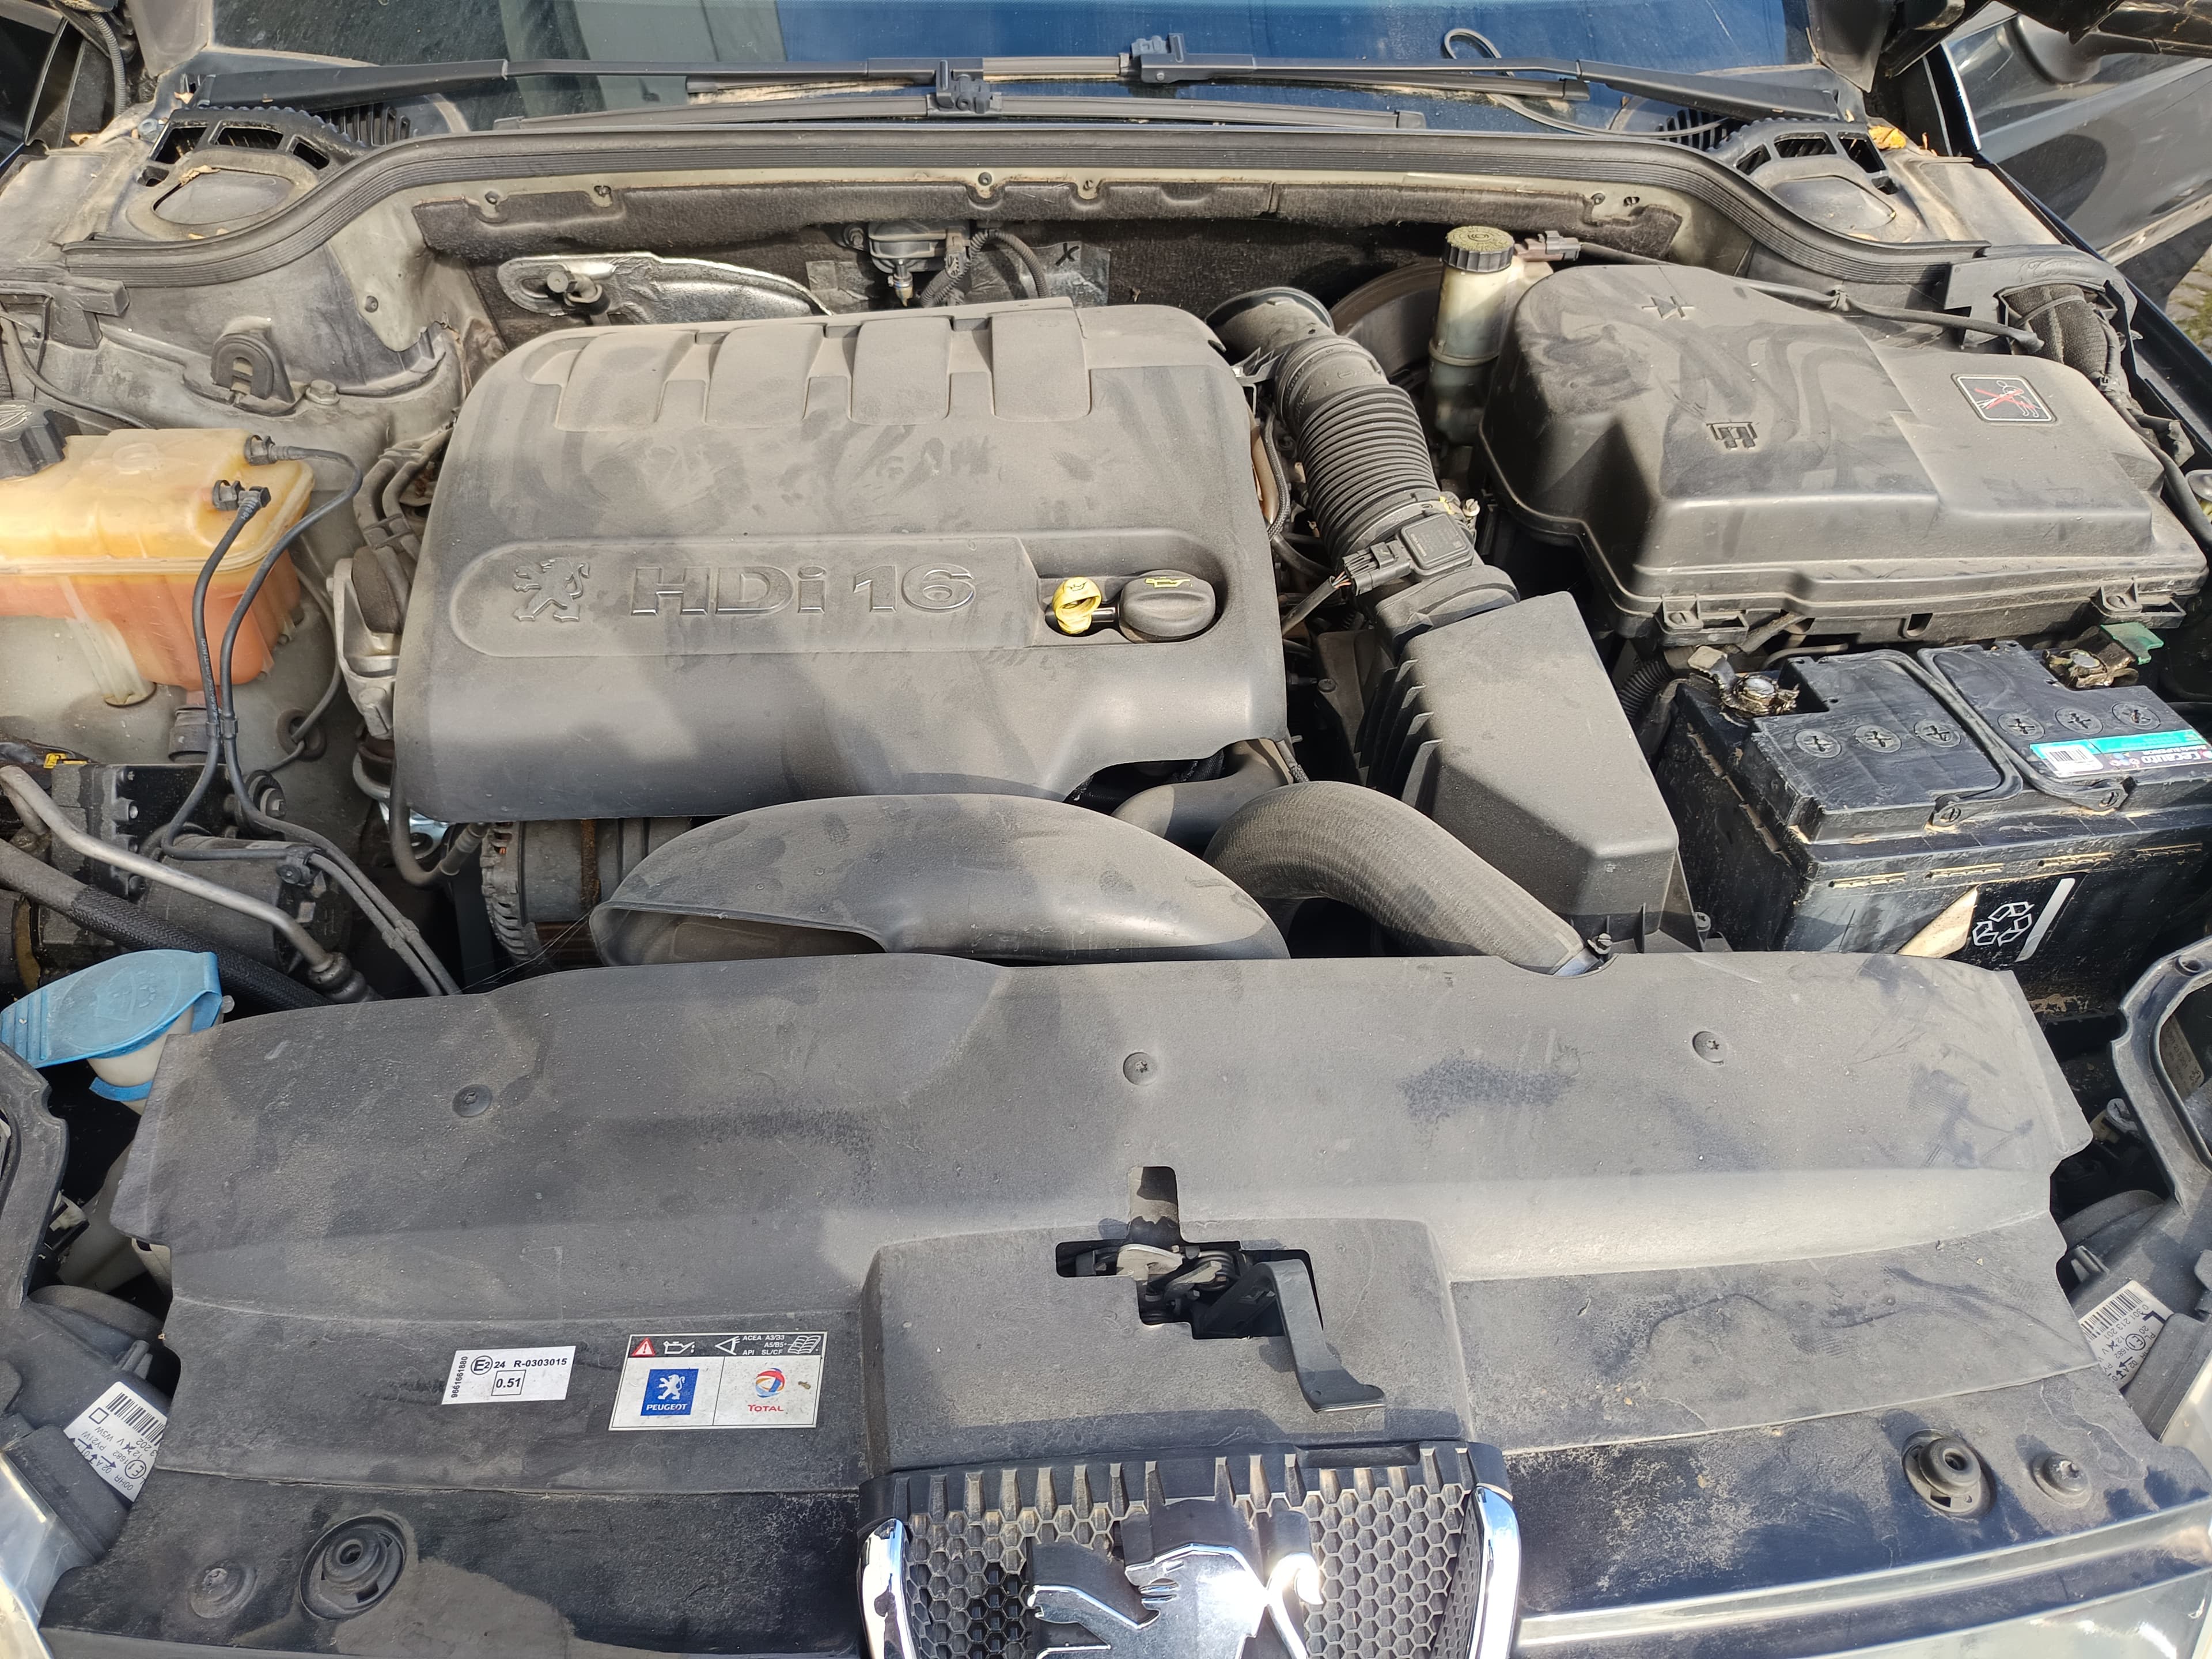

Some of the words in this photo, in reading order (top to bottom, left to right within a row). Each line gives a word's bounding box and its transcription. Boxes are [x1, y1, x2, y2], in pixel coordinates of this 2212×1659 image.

[631, 565, 827, 616] HDi
[853, 563, 976, 613] 16
[2116, 1318, 2131, 1331] 213
[2139, 1325, 2149, 1334] 20
[2104, 1328, 2118, 1340] 201
[2116, 1335, 2126, 1343] 12
[2144, 1332, 2156, 1340] PL
[2115, 1347, 2130, 1359] 1682
[494, 1361, 506, 1369] 24
[514, 1358, 567, 1368] R-0303015
[496, 1377, 521, 1388] 0.51
[95, 1426, 114, 1441] W5W
[81, 1431, 107, 1451] PY21W
[135, 1438, 151, 1452] 202
[112, 1451, 127, 1465] 1682
[132, 1450, 143, 1459] 12
[102, 1464, 112, 1474] 02
